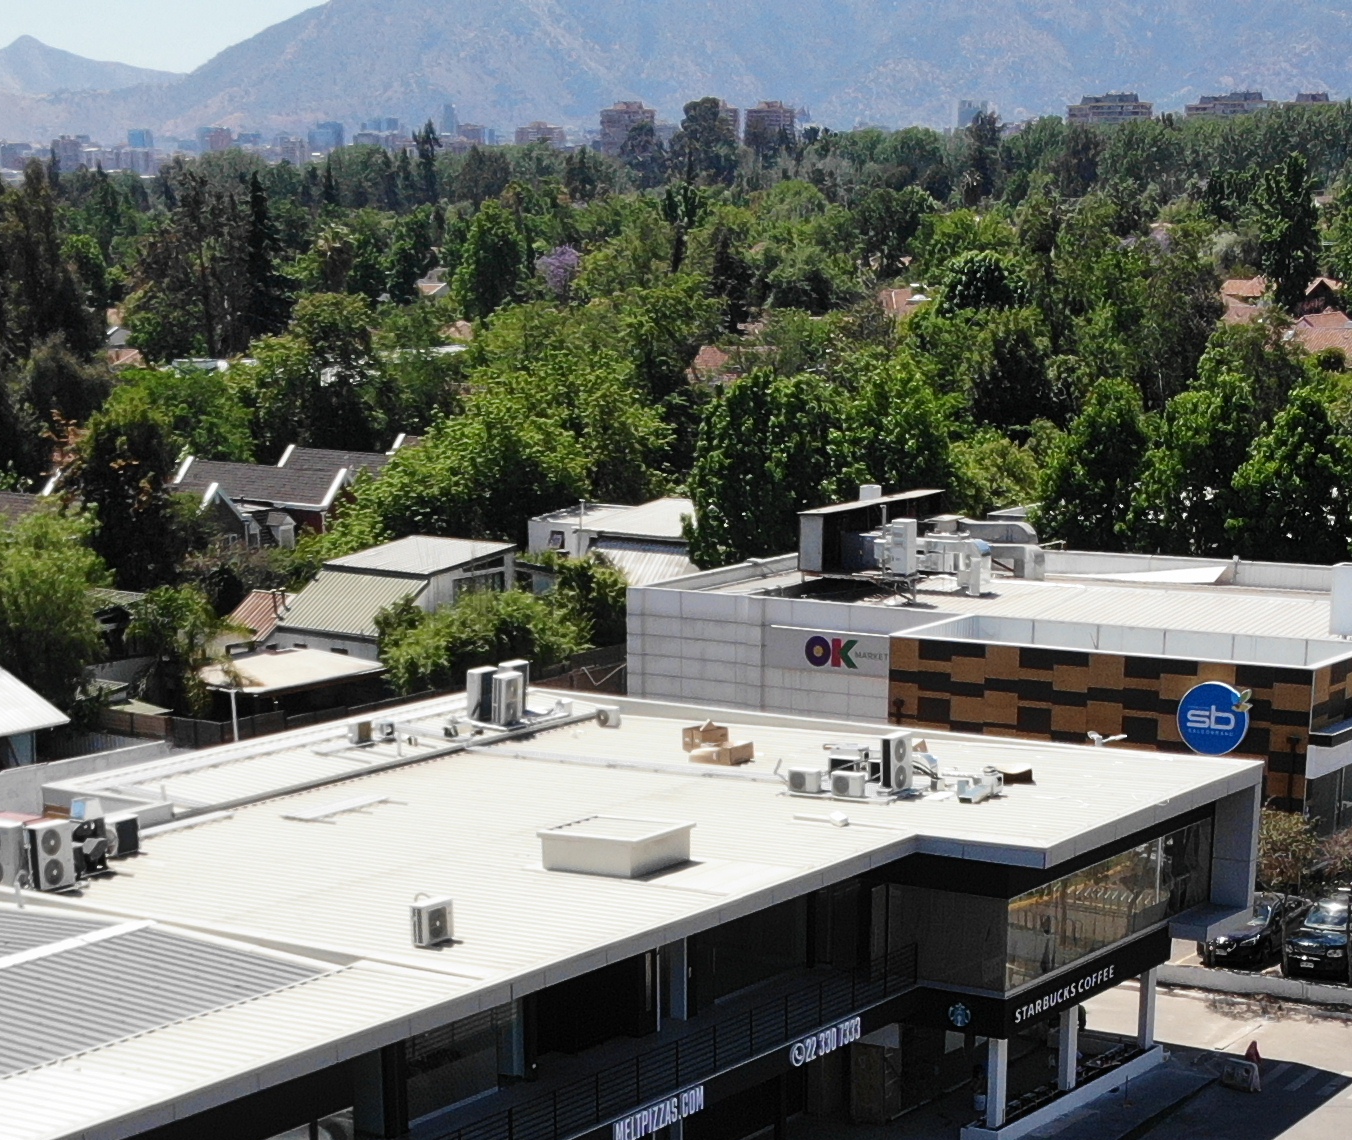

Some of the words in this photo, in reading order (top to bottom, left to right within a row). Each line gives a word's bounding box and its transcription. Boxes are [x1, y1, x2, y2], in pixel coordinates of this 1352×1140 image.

[805, 635, 858, 669] OK
[854, 651, 888, 661] MARKET
[1186, 705, 1235, 730] sb
[1014, 982, 1076, 1024] STARBUCKS
[1077, 964, 1115, 993] COFFEE
[805, 1036, 817, 1063] 22
[818, 1027, 837, 1056] 330
[837, 1016, 861, 1047] 7333
